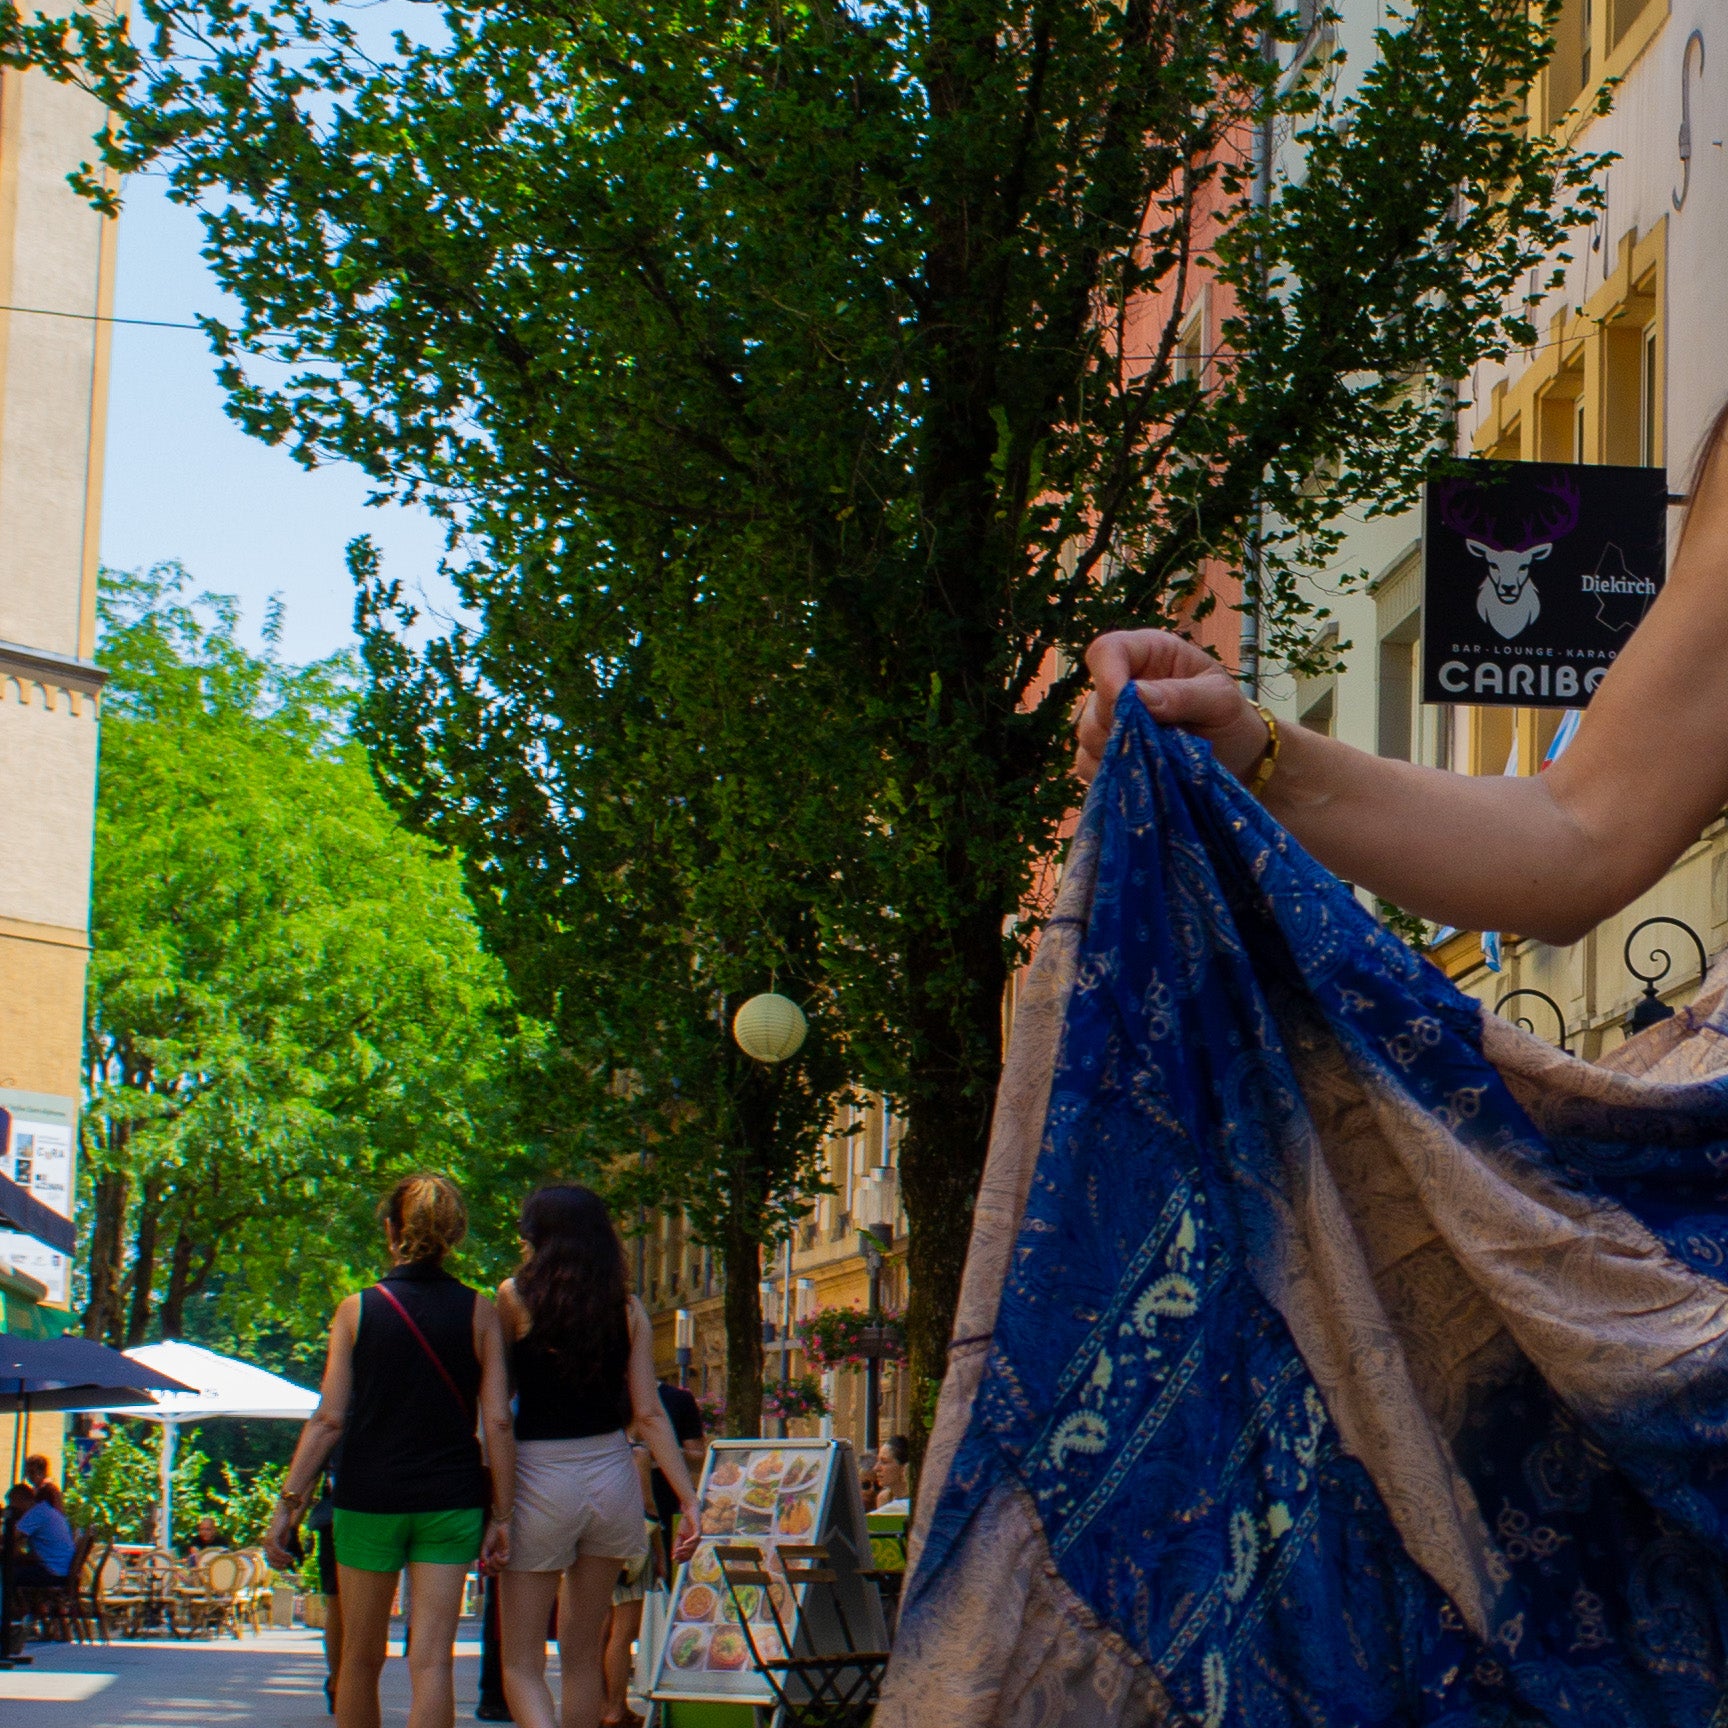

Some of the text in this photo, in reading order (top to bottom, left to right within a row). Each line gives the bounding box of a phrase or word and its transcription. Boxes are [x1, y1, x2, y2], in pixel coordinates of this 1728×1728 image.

[1580, 574, 1656, 595] Diekirch
[1452, 643, 1482, 654] BAR
[1494, 645, 1554, 657] LOUNGE
